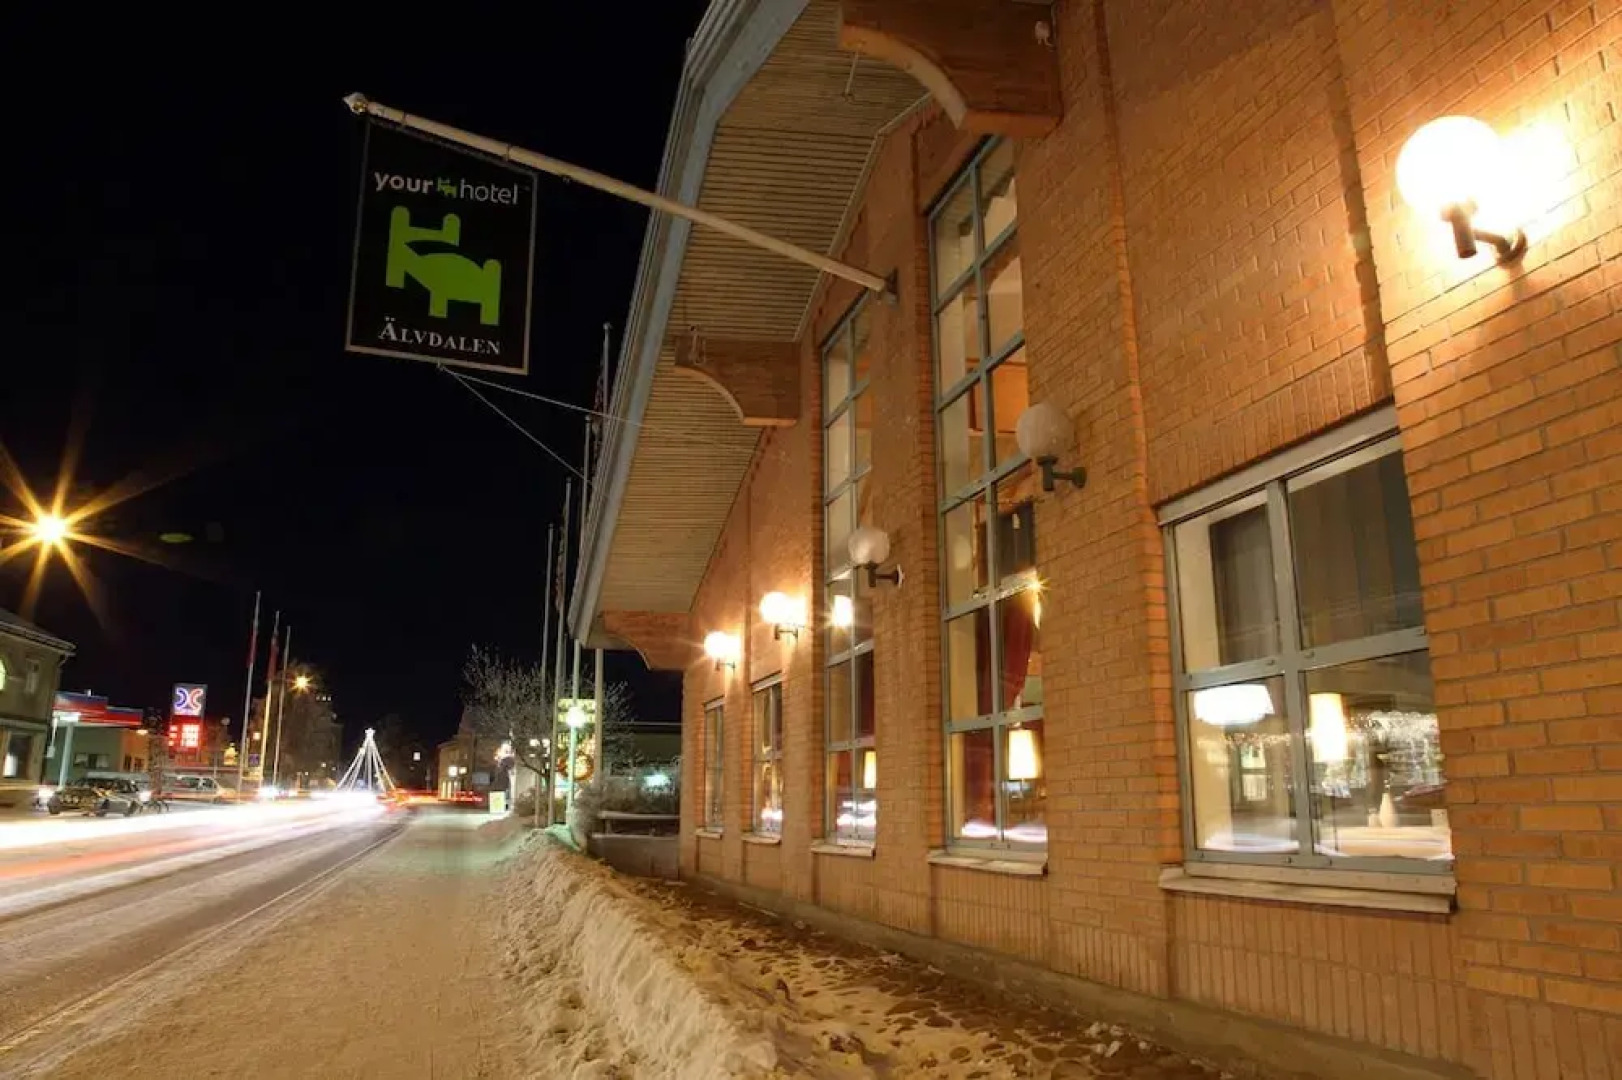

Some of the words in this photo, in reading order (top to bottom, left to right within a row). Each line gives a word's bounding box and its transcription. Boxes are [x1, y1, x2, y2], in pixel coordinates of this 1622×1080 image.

[374, 171, 433, 194] your
[459, 179, 519, 205] hotel
[379, 316, 500, 355] ÄLVDALEN
